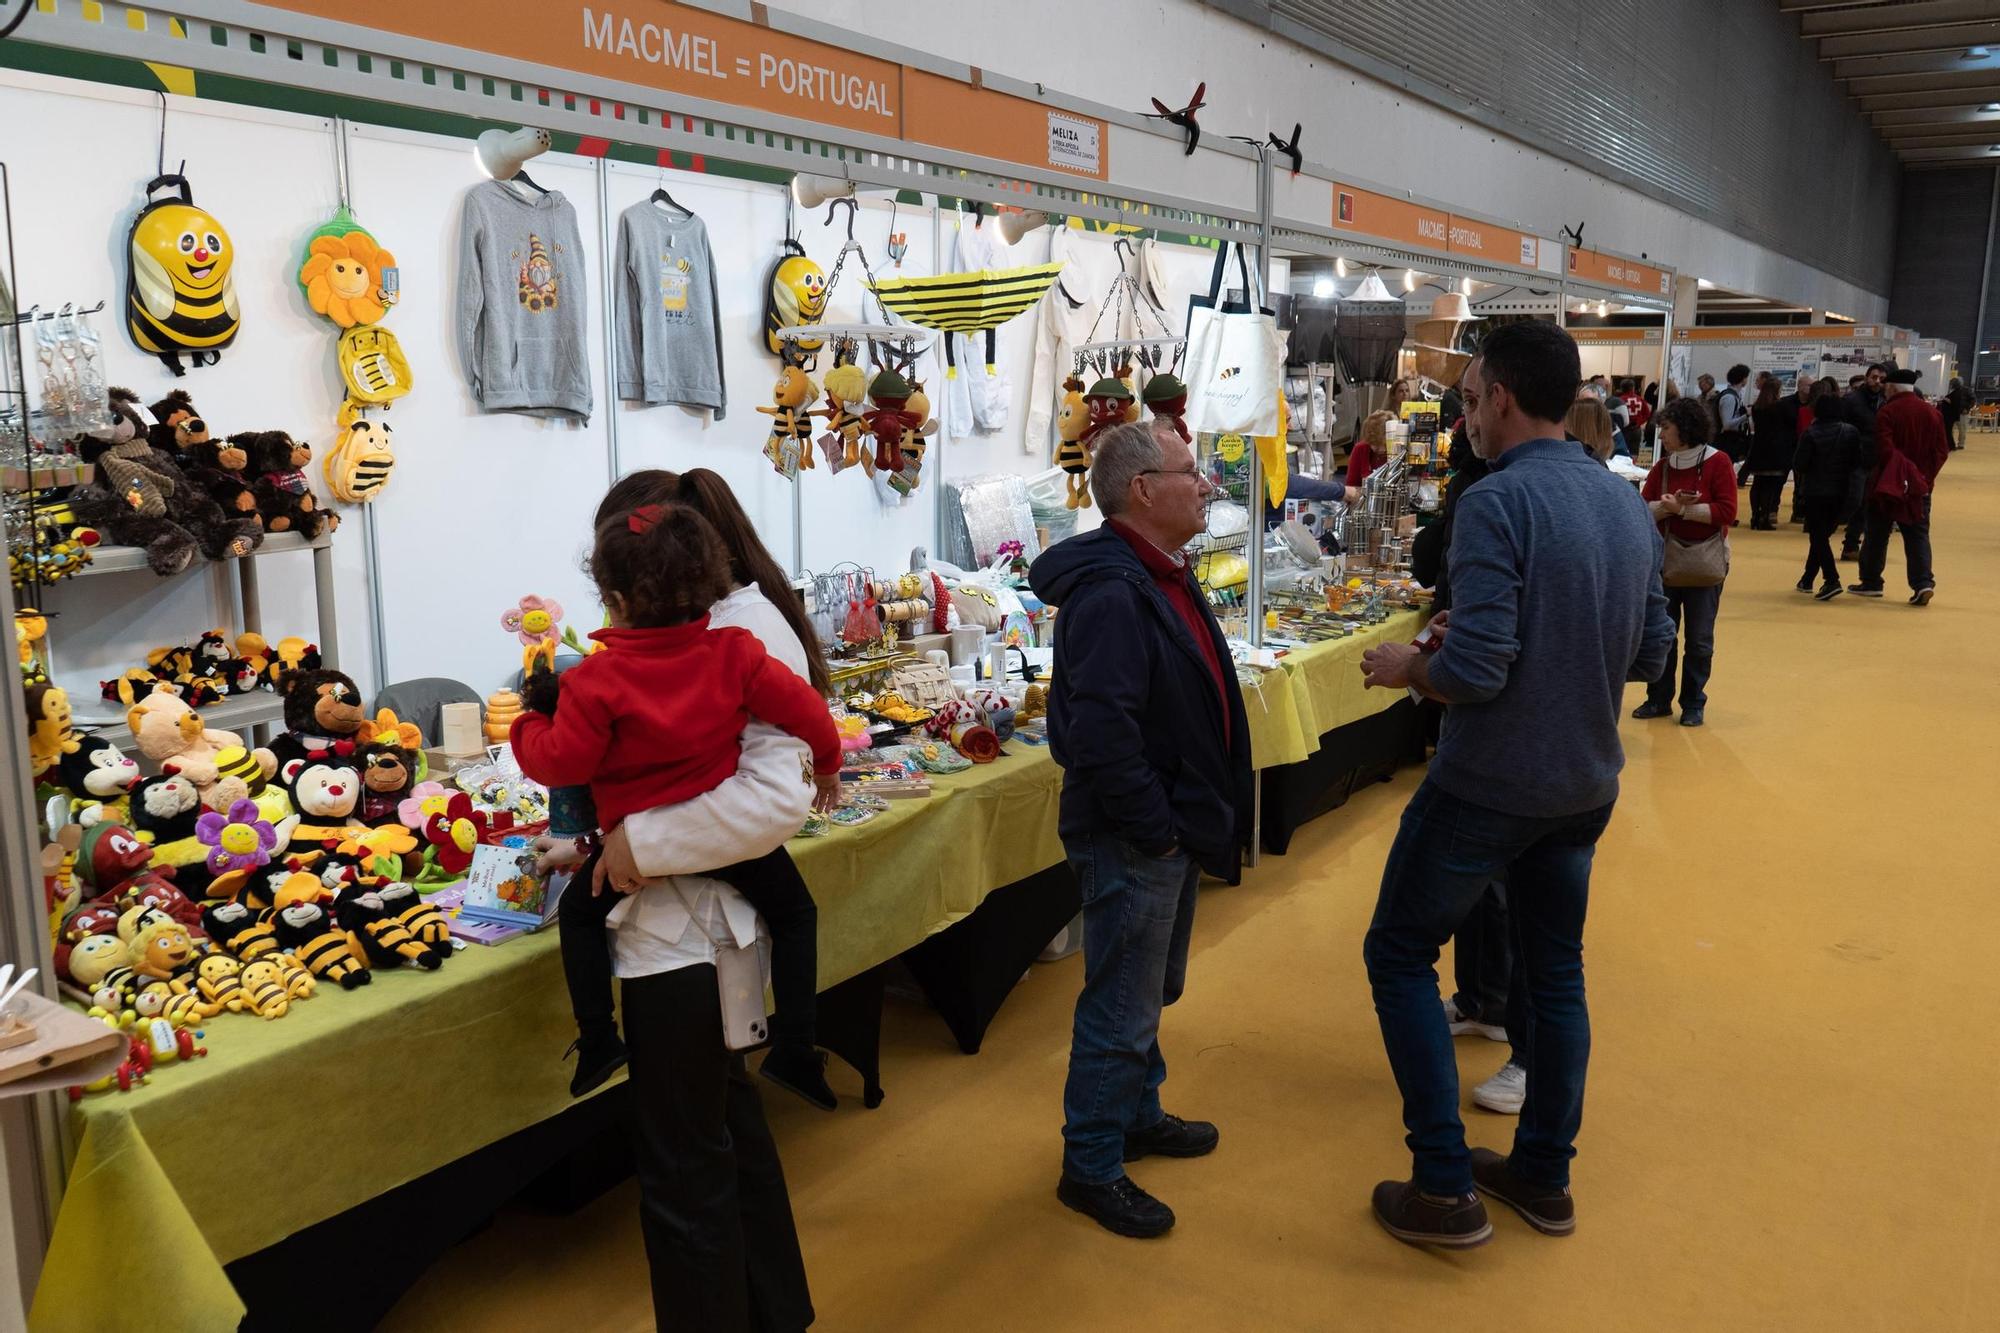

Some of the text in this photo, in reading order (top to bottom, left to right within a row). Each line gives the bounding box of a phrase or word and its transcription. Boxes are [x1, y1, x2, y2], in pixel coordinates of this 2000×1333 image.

[583, 8, 894, 117] MACMEL = PORTUGAL
[1052, 127, 1079, 141] MELIZA
[1418, 218, 1447, 241] MACMEL
